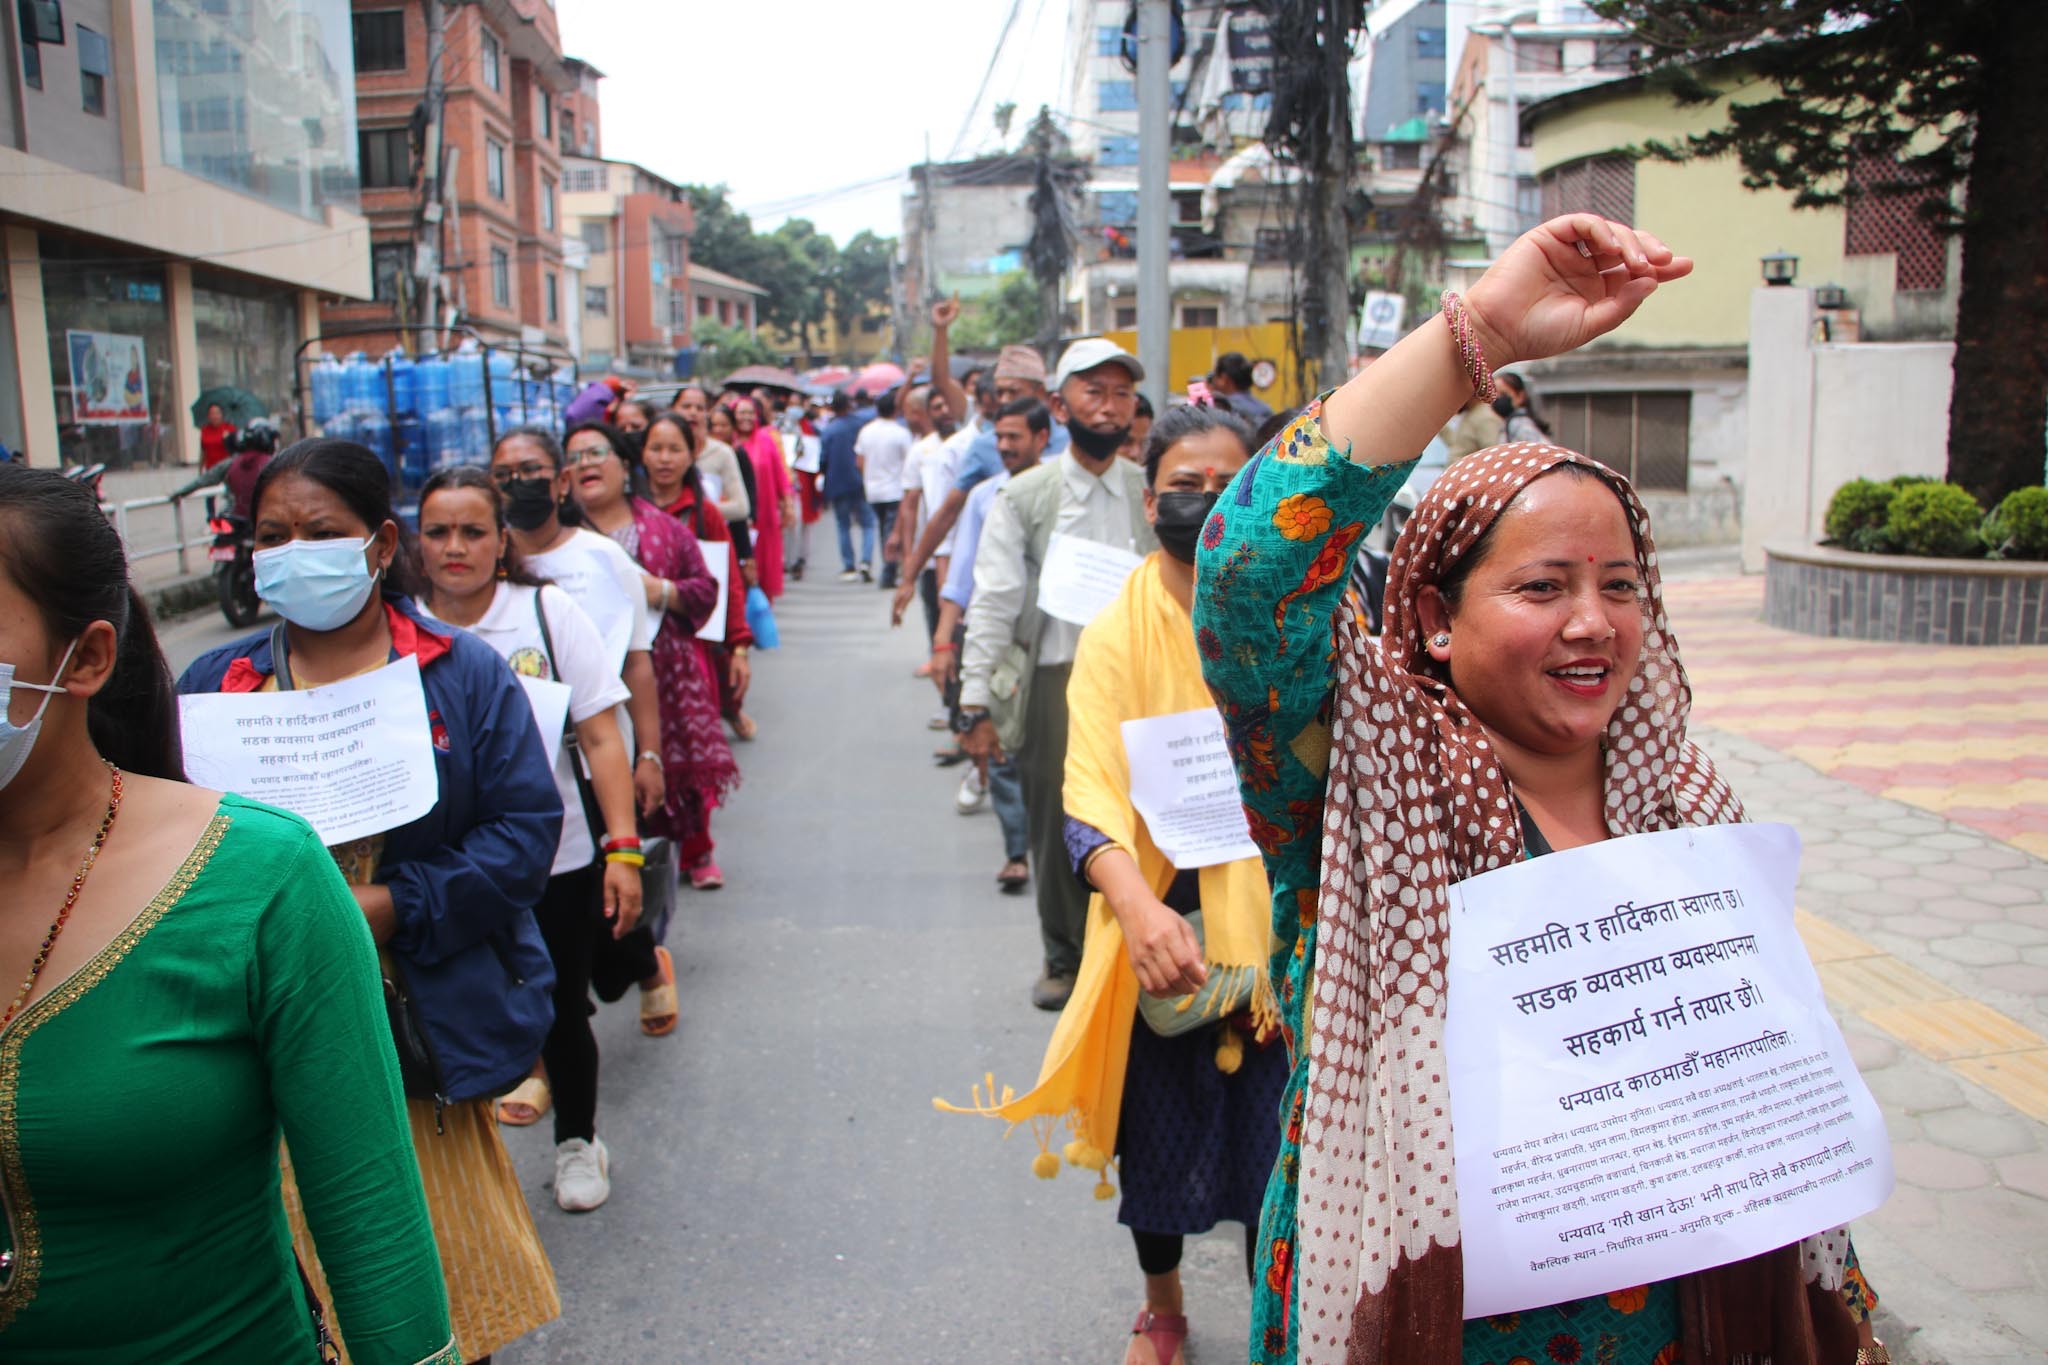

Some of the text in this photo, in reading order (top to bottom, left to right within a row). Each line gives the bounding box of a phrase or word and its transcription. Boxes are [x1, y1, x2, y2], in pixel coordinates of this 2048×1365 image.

[236, 715, 272, 727] सहमति
[241, 735, 270, 746] सडक
[274, 735, 315, 745] व्यवसाय
[258, 751, 298, 766] सहकार्य
[321, 747, 345, 761] तयार
[1488, 889, 1744, 966] सहमति र हार्दिकता स्वागत छ।
[1512, 935, 1759, 1015] सडक व्यवसाय व्यवस्थापनमा
[1563, 1008, 1647, 1057] सहकार्य
[1650, 996, 1687, 1030] गर्न
[1688, 992, 1735, 1021] तयार
[1559, 1081, 1624, 1111] धन्यवाद
[1701, 1030, 1791, 1069] महानगरपालिका
[1493, 1145, 1523, 1159] धन्यवाद
[1524, 1139, 1542, 1150] मेयर
[1570, 1123, 1599, 1137] धन्यवाद
[1600, 1114, 1628, 1129] उपमेयर
[1657, 1097, 1685, 1111] धन्यवाद
[1501, 1160, 1530, 1174] महर्जन,
[1588, 1138, 1607, 1152] भुवन
[1559, 1222, 1606, 1243] धन्यवाद
[1636, 1205, 1665, 1222] खान
[1700, 1184, 1724, 1202] भनी
[1725, 1179, 1749, 1195] साथ
[1749, 1168, 1770, 1188] दिने
[1788, 1146, 1833, 1174] करुणादायी
[1530, 1255, 1570, 1271] वैकल्पिक
[1573, 1248, 1597, 1261] स्थान
[1606, 1236, 1644, 1253] निर्धारित
[1645, 1229, 1669, 1242] समय
[1679, 1215, 1712, 1233] अनुमति
[1712, 1210, 1734, 1225] शुल्क
